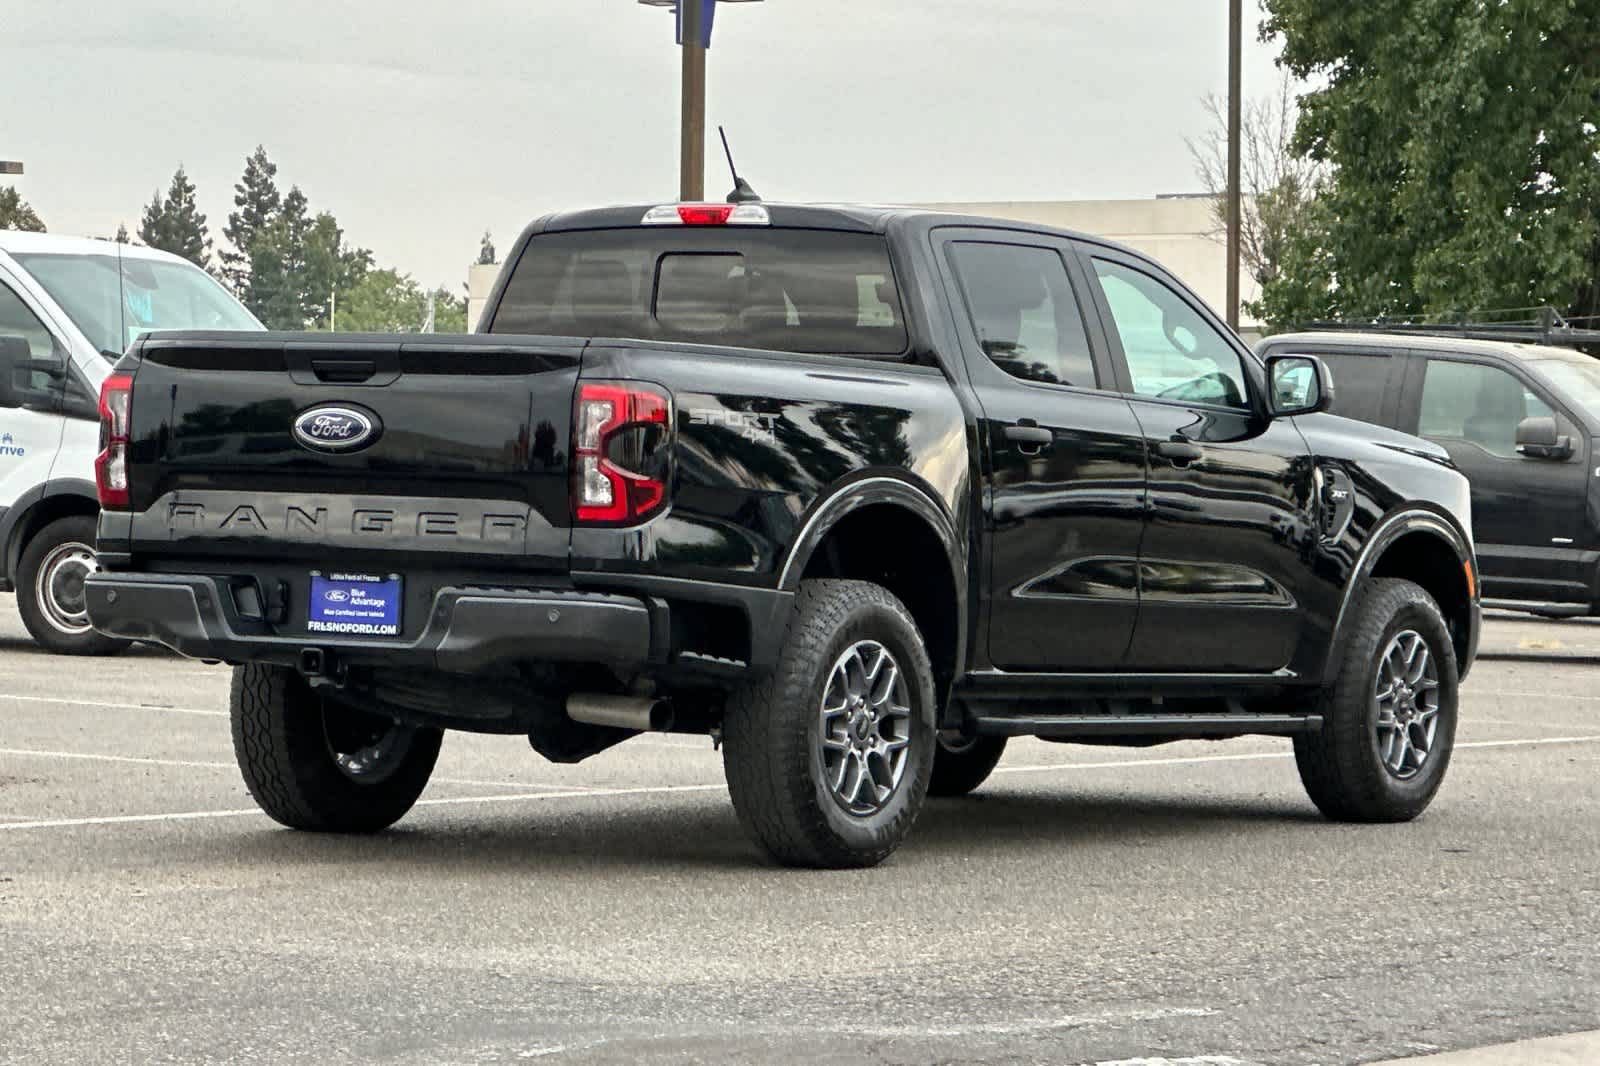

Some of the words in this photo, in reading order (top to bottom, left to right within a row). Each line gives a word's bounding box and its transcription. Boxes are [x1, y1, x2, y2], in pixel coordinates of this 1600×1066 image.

[311, 415, 352, 436] Ford
[688, 408, 781, 431] SPORT
[166, 502, 526, 542] RANGER
[329, 591, 345, 600] Ford
[351, 588, 366, 597] Blue
[350, 597, 385, 607] Advantage
[308, 621, 397, 634] FRESNOFORD.COM
